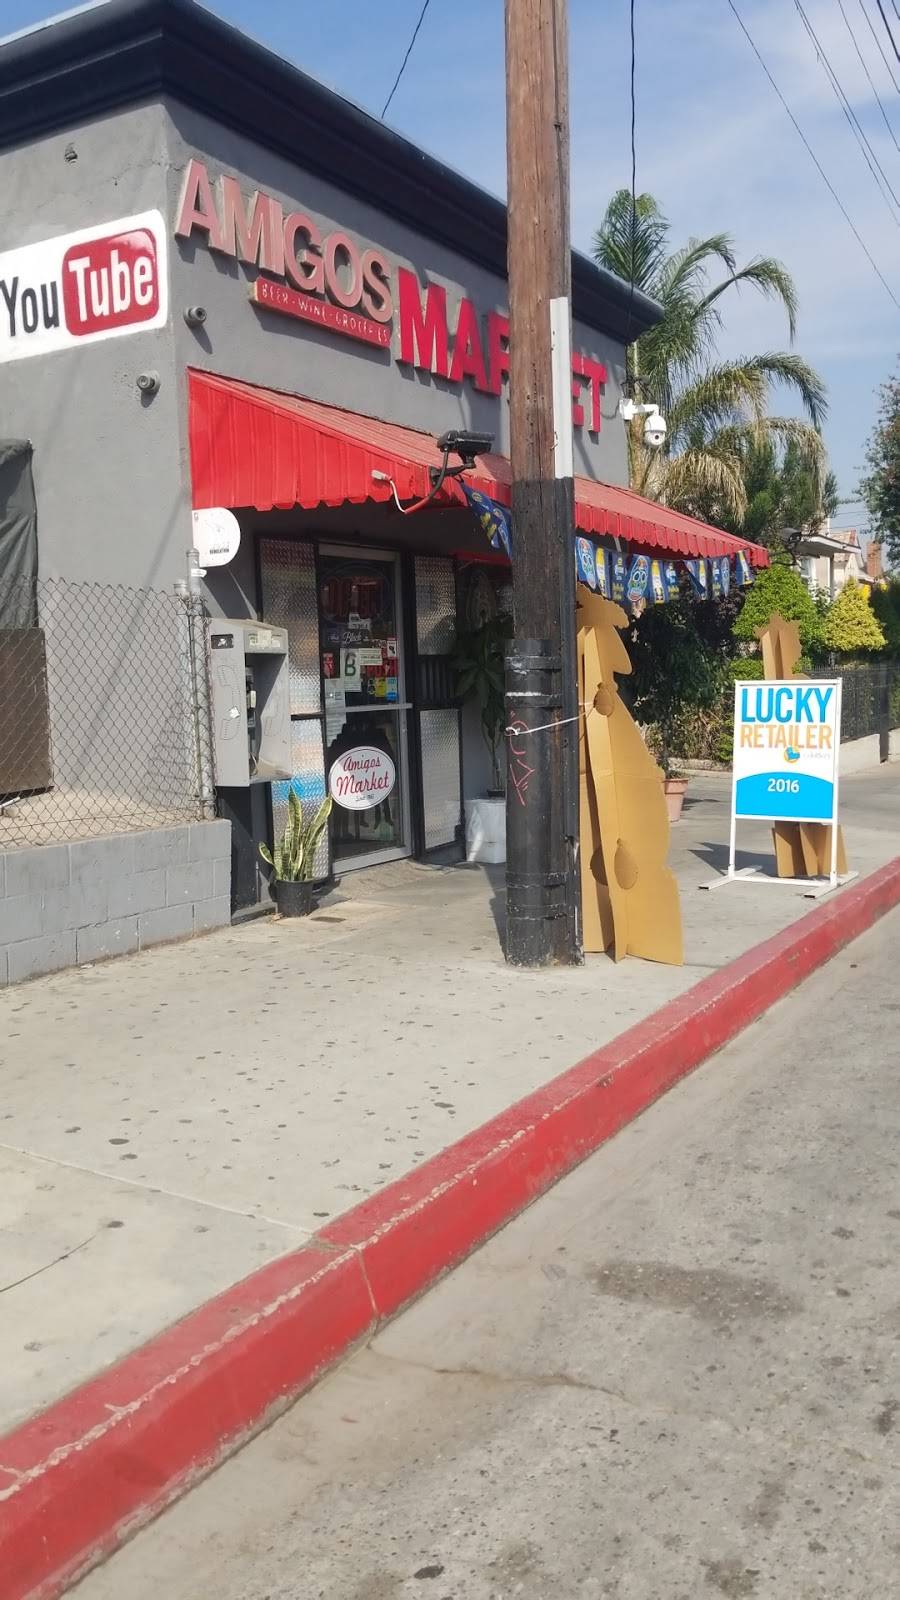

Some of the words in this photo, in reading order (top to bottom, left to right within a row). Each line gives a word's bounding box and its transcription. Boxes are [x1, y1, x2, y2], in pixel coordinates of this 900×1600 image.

[175, 158, 393, 323] AMIGOS
[398, 266, 608, 433] MARET
[742, 687, 834, 723] LUCKY
[740, 724, 832, 750] RETAILER
[343, 756, 381, 773] Amigos
[336, 770, 390, 796] Market
[767, 778, 800, 793] 2016
